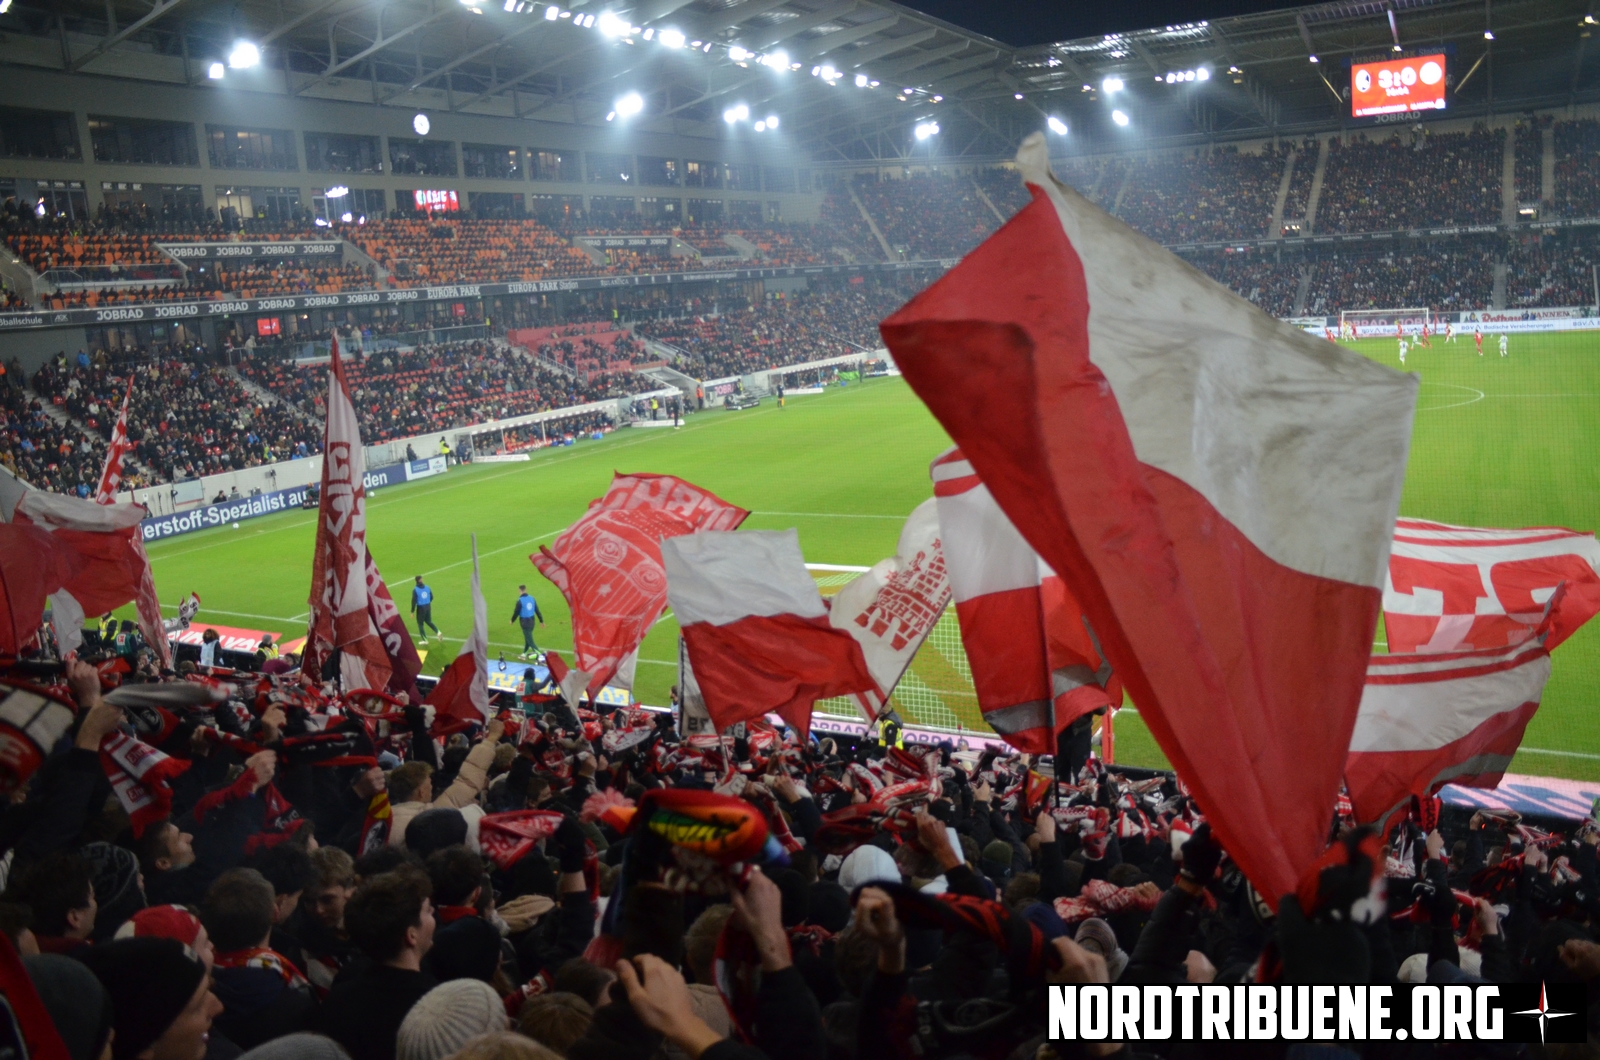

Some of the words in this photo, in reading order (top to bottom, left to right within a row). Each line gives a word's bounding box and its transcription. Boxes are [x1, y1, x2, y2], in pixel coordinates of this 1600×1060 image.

[1374, 111, 1421, 123] JOBRAD
[168, 248, 206, 257] JOBRAD
[216, 246, 252, 256] JOBRAD
[262, 246, 296, 254] JOBRAD
[303, 244, 336, 253] JOBRAD
[427, 287, 458, 299] EUROPA
[460, 286, 480, 296] PARK
[508, 283, 538, 293] EUROPA
[540, 282, 559, 291] PARK
[560, 281, 578, 290] Stadion
[304, 296, 339, 307] JOBRAD
[347, 294, 380, 304] JOBRAD
[387, 291, 418, 301] JOBRAD
[208, 302, 248, 314] JOBRAD
[258, 299, 296, 310] JOBRAD
[96, 308, 144, 321] JOBRAD
[155, 305, 198, 317] JOBRAD
[1481, 313, 1522, 322] Rothau
[289, 490, 308, 504] au
[363, 472, 388, 488] den
